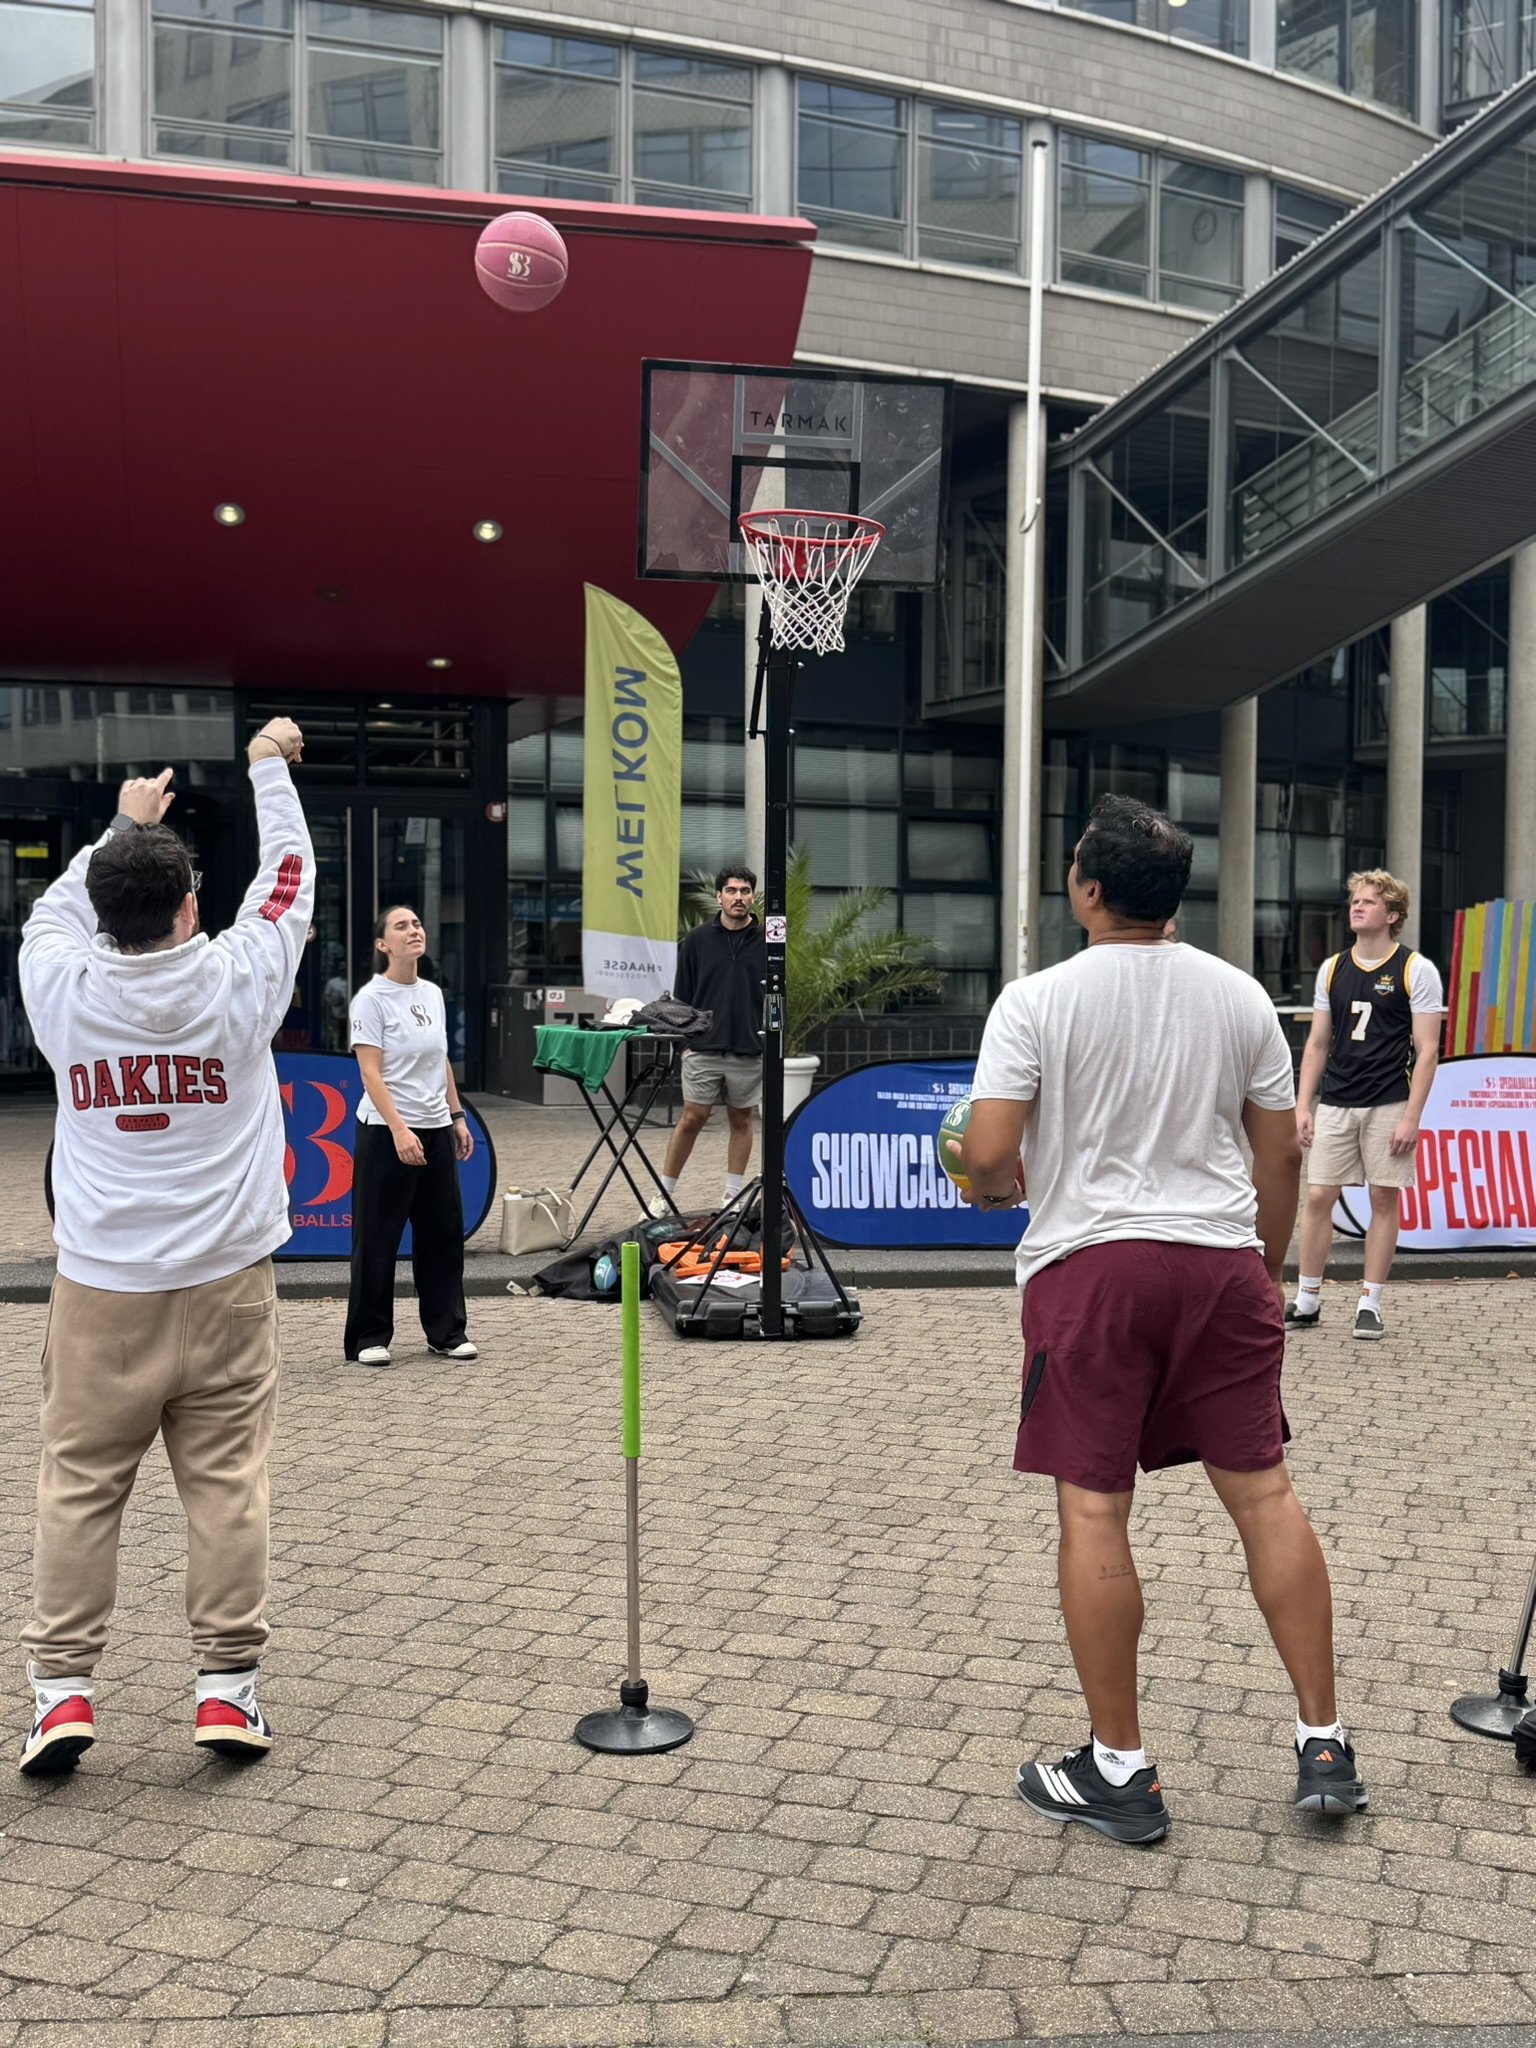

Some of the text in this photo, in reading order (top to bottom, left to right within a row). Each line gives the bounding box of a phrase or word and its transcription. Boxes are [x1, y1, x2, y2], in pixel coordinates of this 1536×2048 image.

[750, 411, 847, 432] TARMAK
[1351, 1001, 1373, 1041] 7
[69, 1055, 228, 1111] OAKIES
[293, 1213, 353, 1228] BALLS
